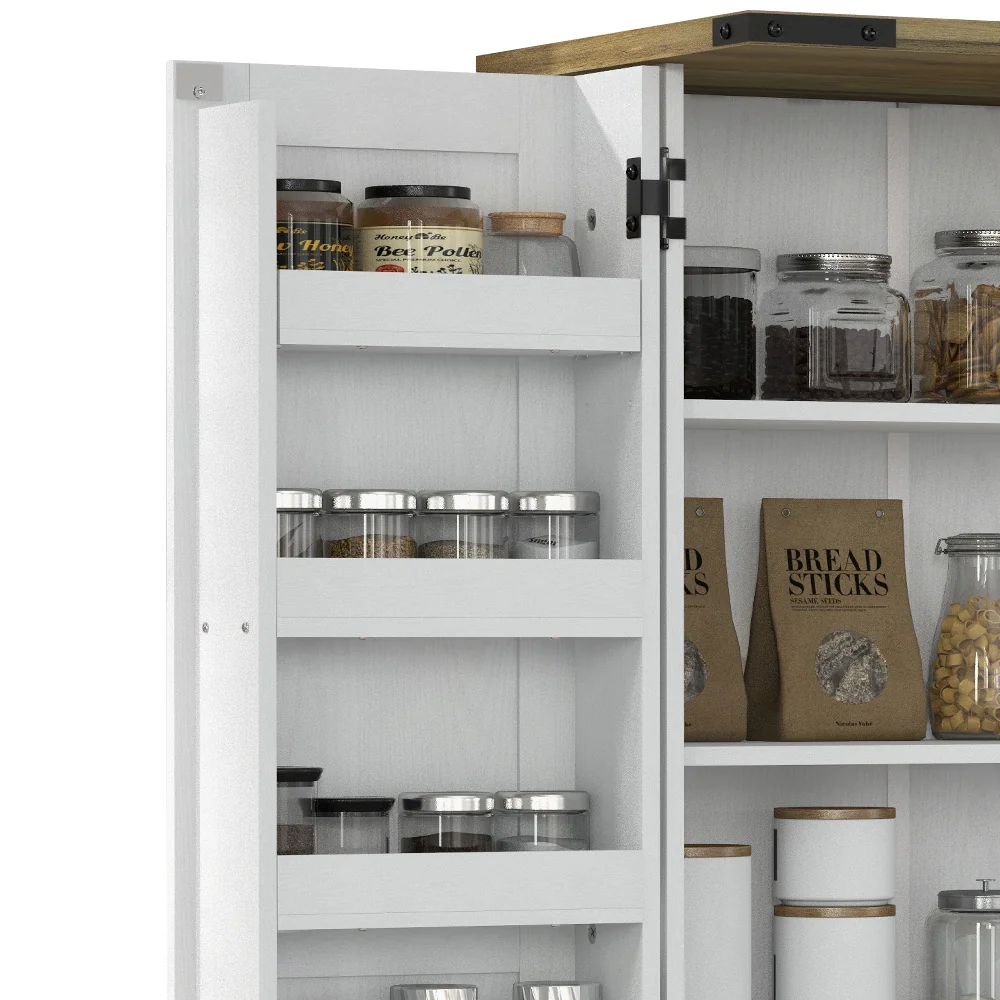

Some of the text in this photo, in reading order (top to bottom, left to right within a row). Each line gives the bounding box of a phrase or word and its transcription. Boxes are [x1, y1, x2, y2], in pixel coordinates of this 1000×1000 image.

[374, 245, 482, 259] Bee Pollen
[784, 548, 882, 572] BREAD
[788, 572, 889, 597] STICKS
